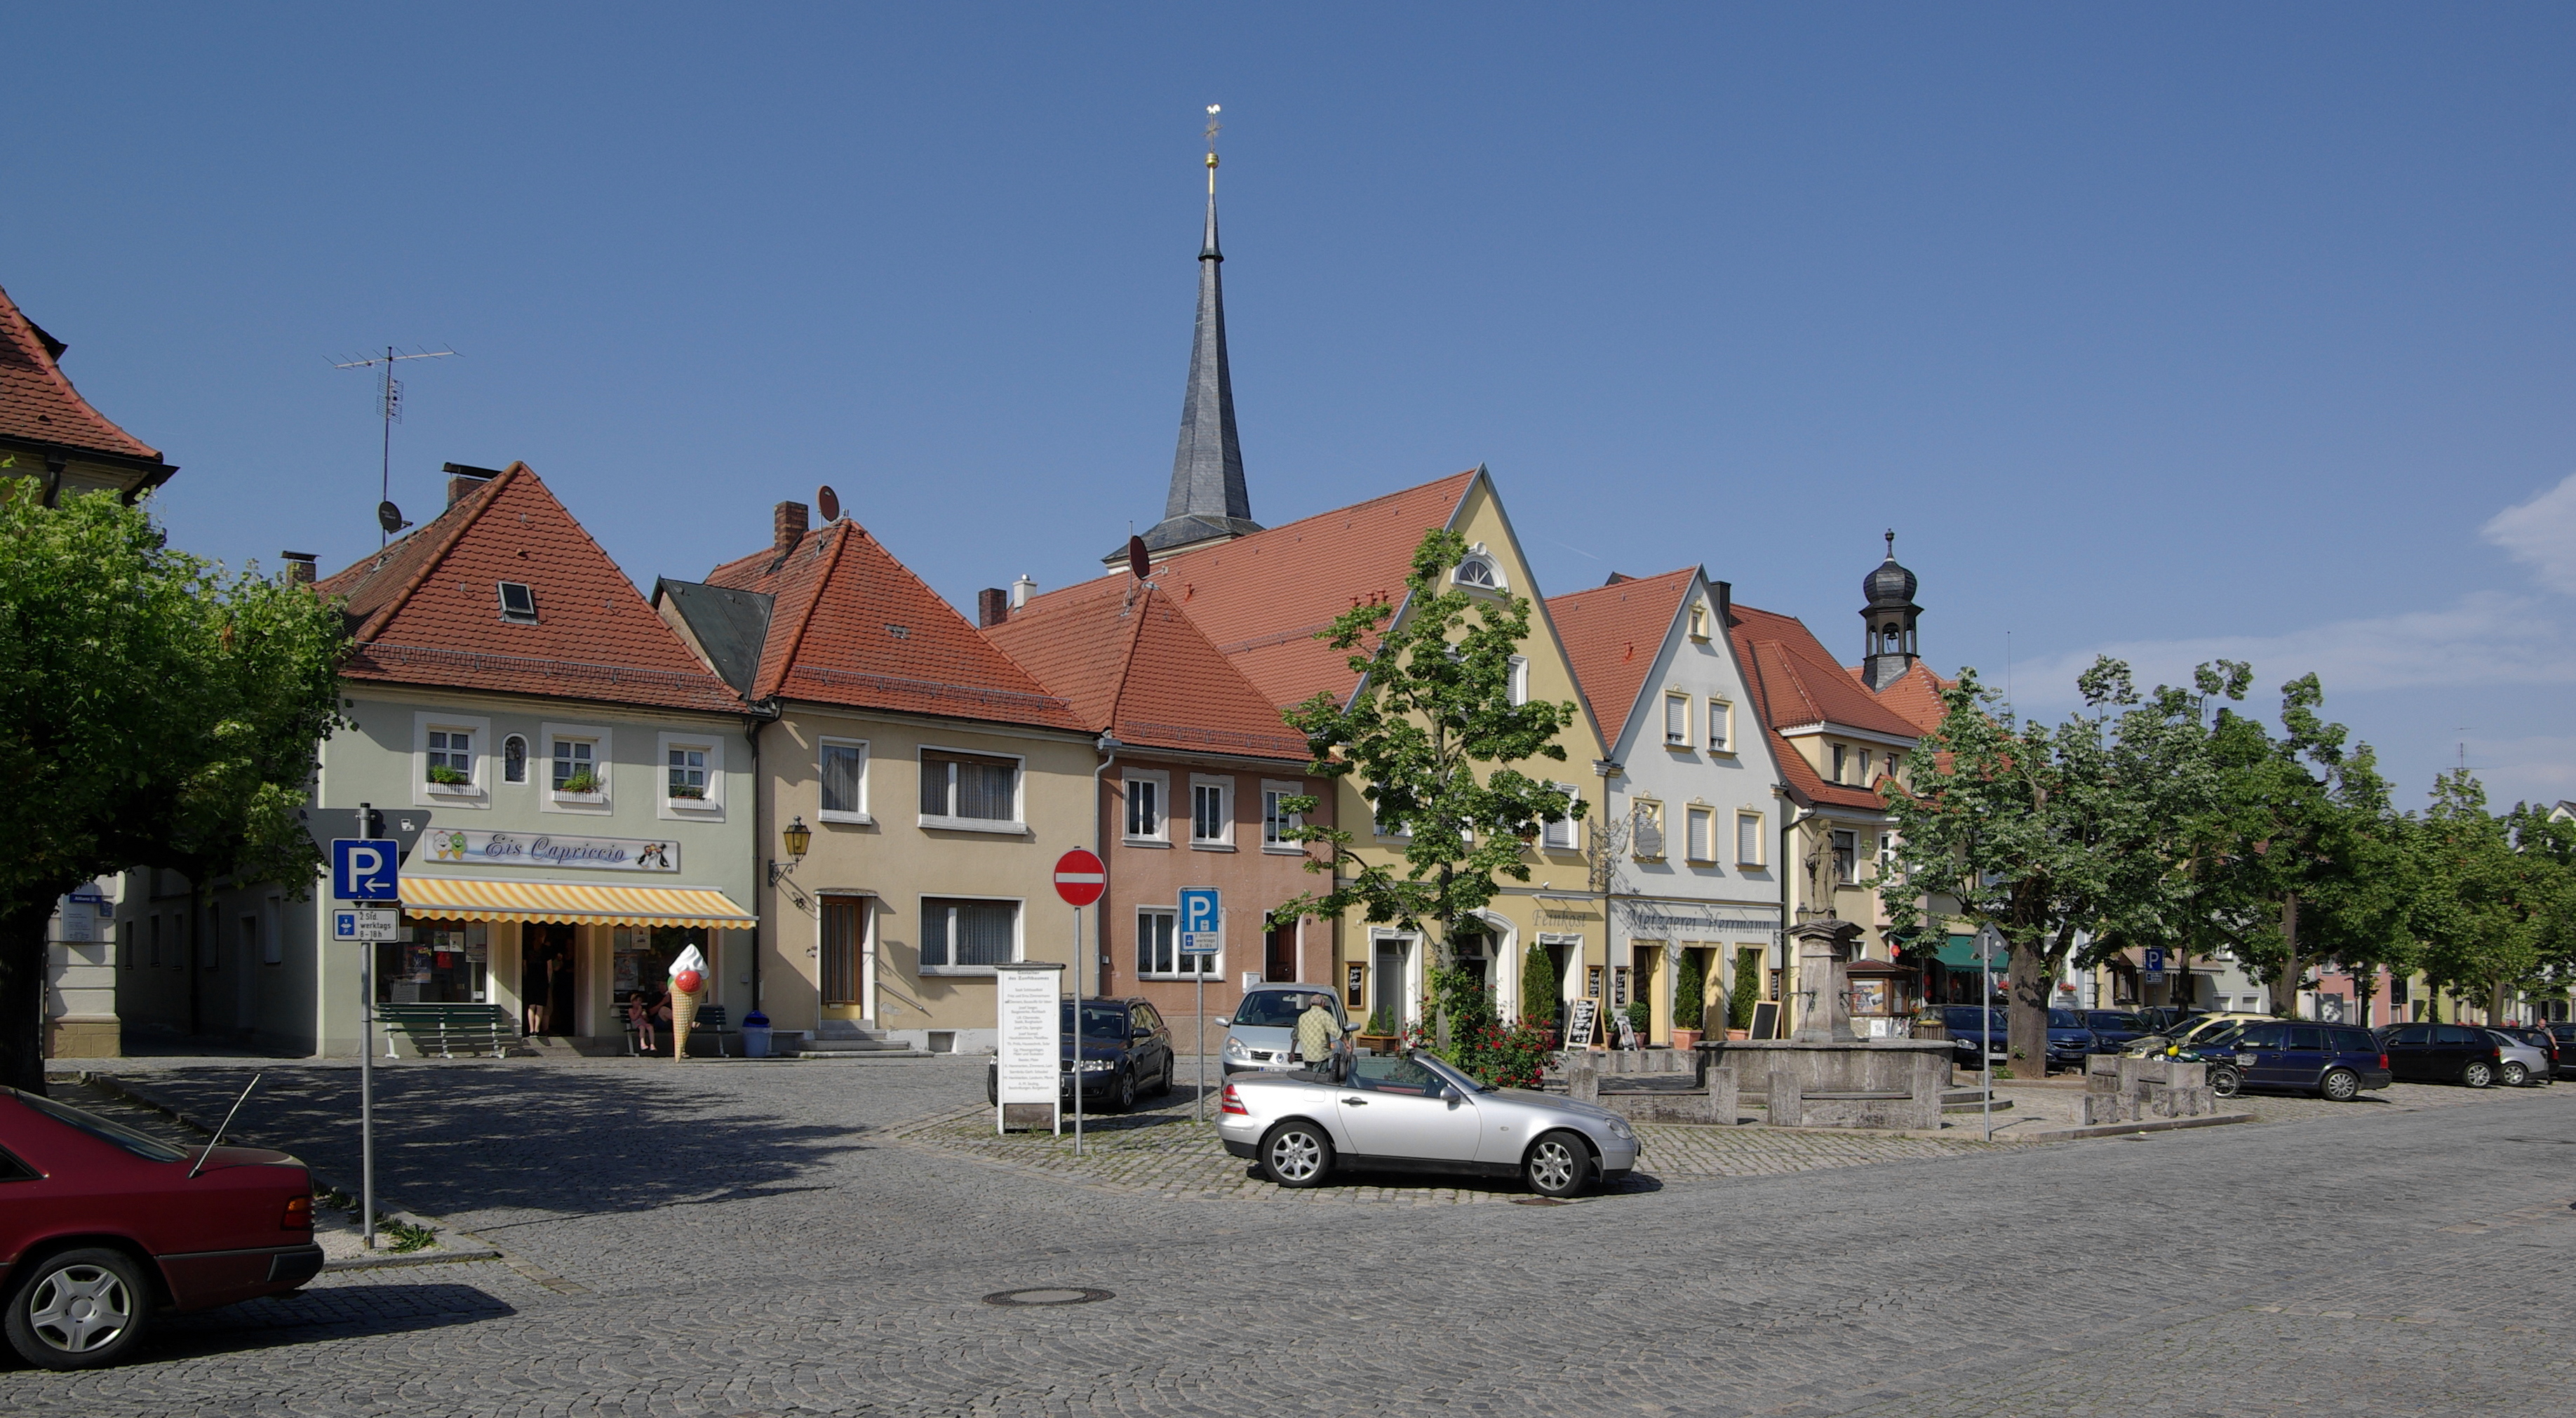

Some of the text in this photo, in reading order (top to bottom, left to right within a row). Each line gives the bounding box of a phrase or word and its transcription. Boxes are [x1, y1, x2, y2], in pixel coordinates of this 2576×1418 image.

[485, 833, 624, 864] Eis Capriccio
[349, 847, 383, 892] P
[360, 921, 391, 930] werktags
[1189, 896, 1211, 931] P
[1532, 908, 1587, 932] Feinkost
[1627, 909, 1771, 938] Metzgerei Herrmann
[2149, 951, 2159, 968] P
